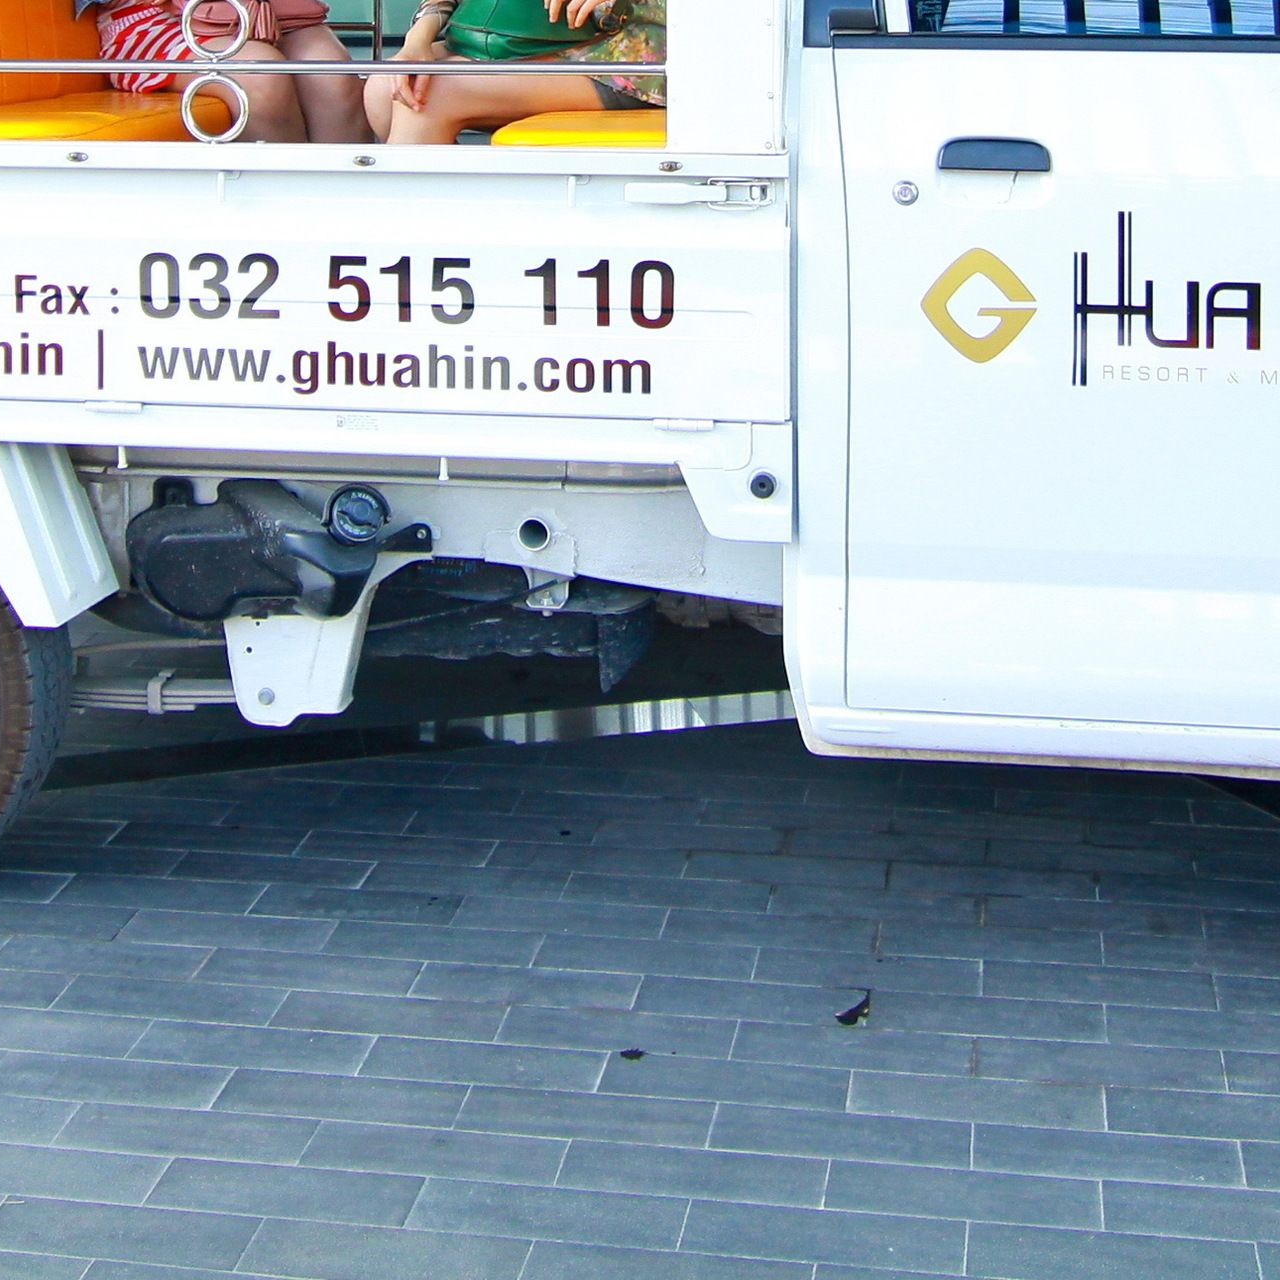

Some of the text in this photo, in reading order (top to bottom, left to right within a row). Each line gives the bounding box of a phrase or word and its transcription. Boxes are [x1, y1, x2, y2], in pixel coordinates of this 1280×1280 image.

[14, 274, 90, 316] Fax
[139, 252, 281, 320] 032
[327, 255, 475, 325] 515
[523, 257, 675, 330] 110
[1071, 210, 1262, 387] HUA
[137, 340, 652, 395] www.ghuahin.com
[1102, 364, 1208, 384] RESORT
